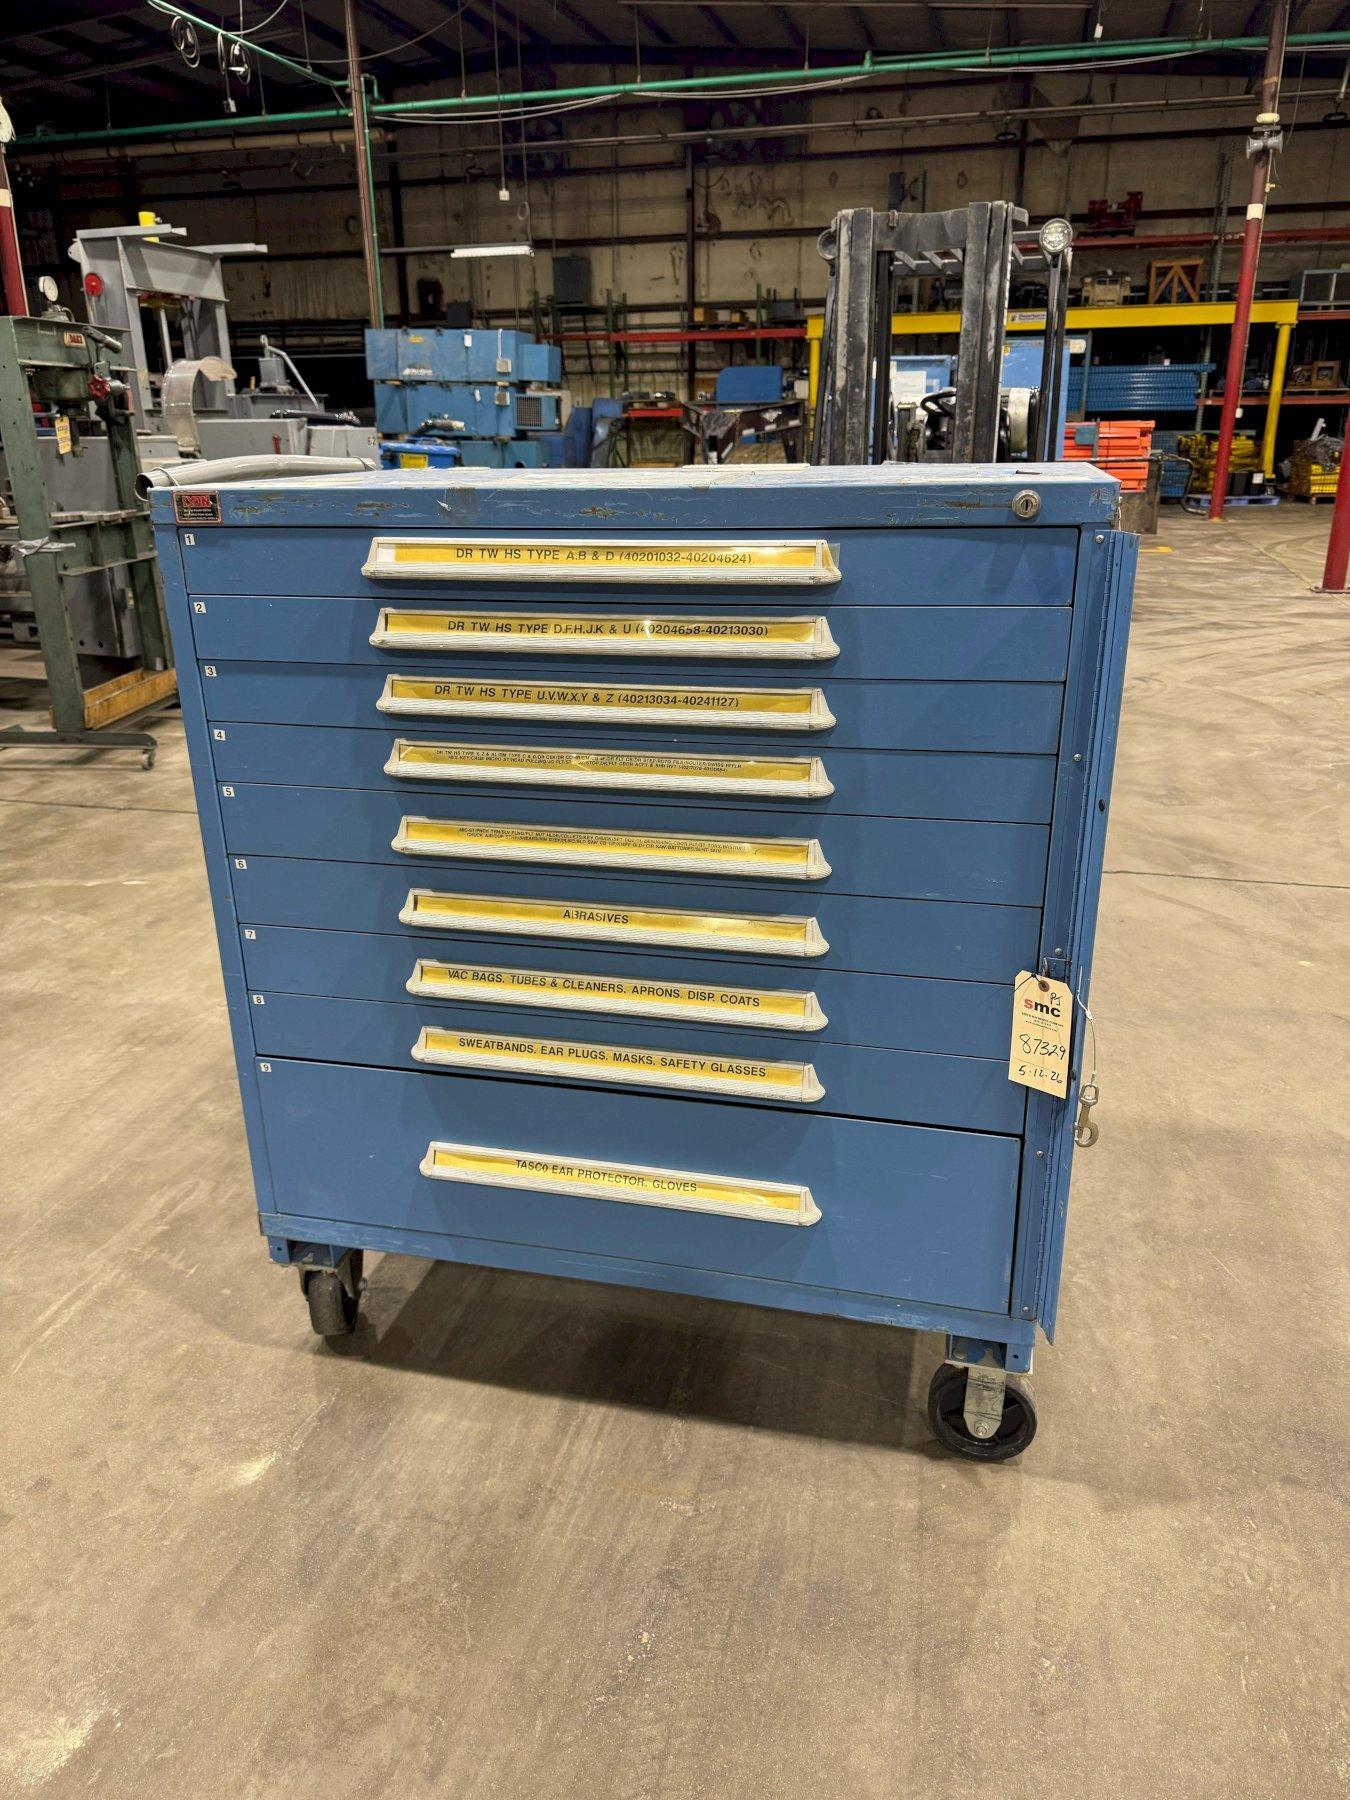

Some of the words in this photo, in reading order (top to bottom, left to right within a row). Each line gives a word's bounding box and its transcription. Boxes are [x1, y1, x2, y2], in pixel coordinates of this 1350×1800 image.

[186, 534, 192, 545] 1
[456, 548, 473, 559] DR
[480, 548, 499, 559] TW
[504, 549, 521, 559] HS
[528, 549, 560, 560] TYPE
[591, 550, 600, 561] &
[605, 551, 615, 561] D
[619, 551, 752, 564] (40201032-40204624)
[196, 603, 204, 613] 2
[448, 620, 465, 631] DR
[471, 622, 490, 632] TW
[495, 623, 512, 633] HS
[518, 624, 548, 634] TYPE
[608, 625, 617, 634] &
[623, 624, 631, 634] U
[207, 667, 215, 676] 3
[434, 685, 451, 695] DR
[456, 686, 475, 696] TW
[479, 688, 496, 697] HS
[502, 689, 533, 700] TYPE
[592, 692, 600, 703] &
[606, 694, 614, 703] Z
[618, 693, 740, 708] (40213034-40241127)
[216, 731, 223, 740] 4
[225, 786, 233, 796] 5
[237, 860, 245, 869] 6
[563, 909, 629, 924] ABRASIVES
[246, 930, 253, 939] 7
[448, 970, 468, 980] VAC
[511, 975, 547, 987] TUBES
[551, 979, 558, 988] &
[688, 990, 715, 1002] DISP.
[720, 993, 760, 1007] COATS
[254, 995, 263, 1004] 8
[1024, 998, 1060, 1018] smc
[1019, 1033, 1066, 1060] 87329
[541, 1045, 564, 1056] EAR
[660, 1057, 706, 1070] SAFETY
[710, 1062, 766, 1077] GLASSES
[263, 1063, 270, 1072] 9
[551, 1164, 574, 1176] EAR
[652, 1179, 697, 1192] GLOVES
